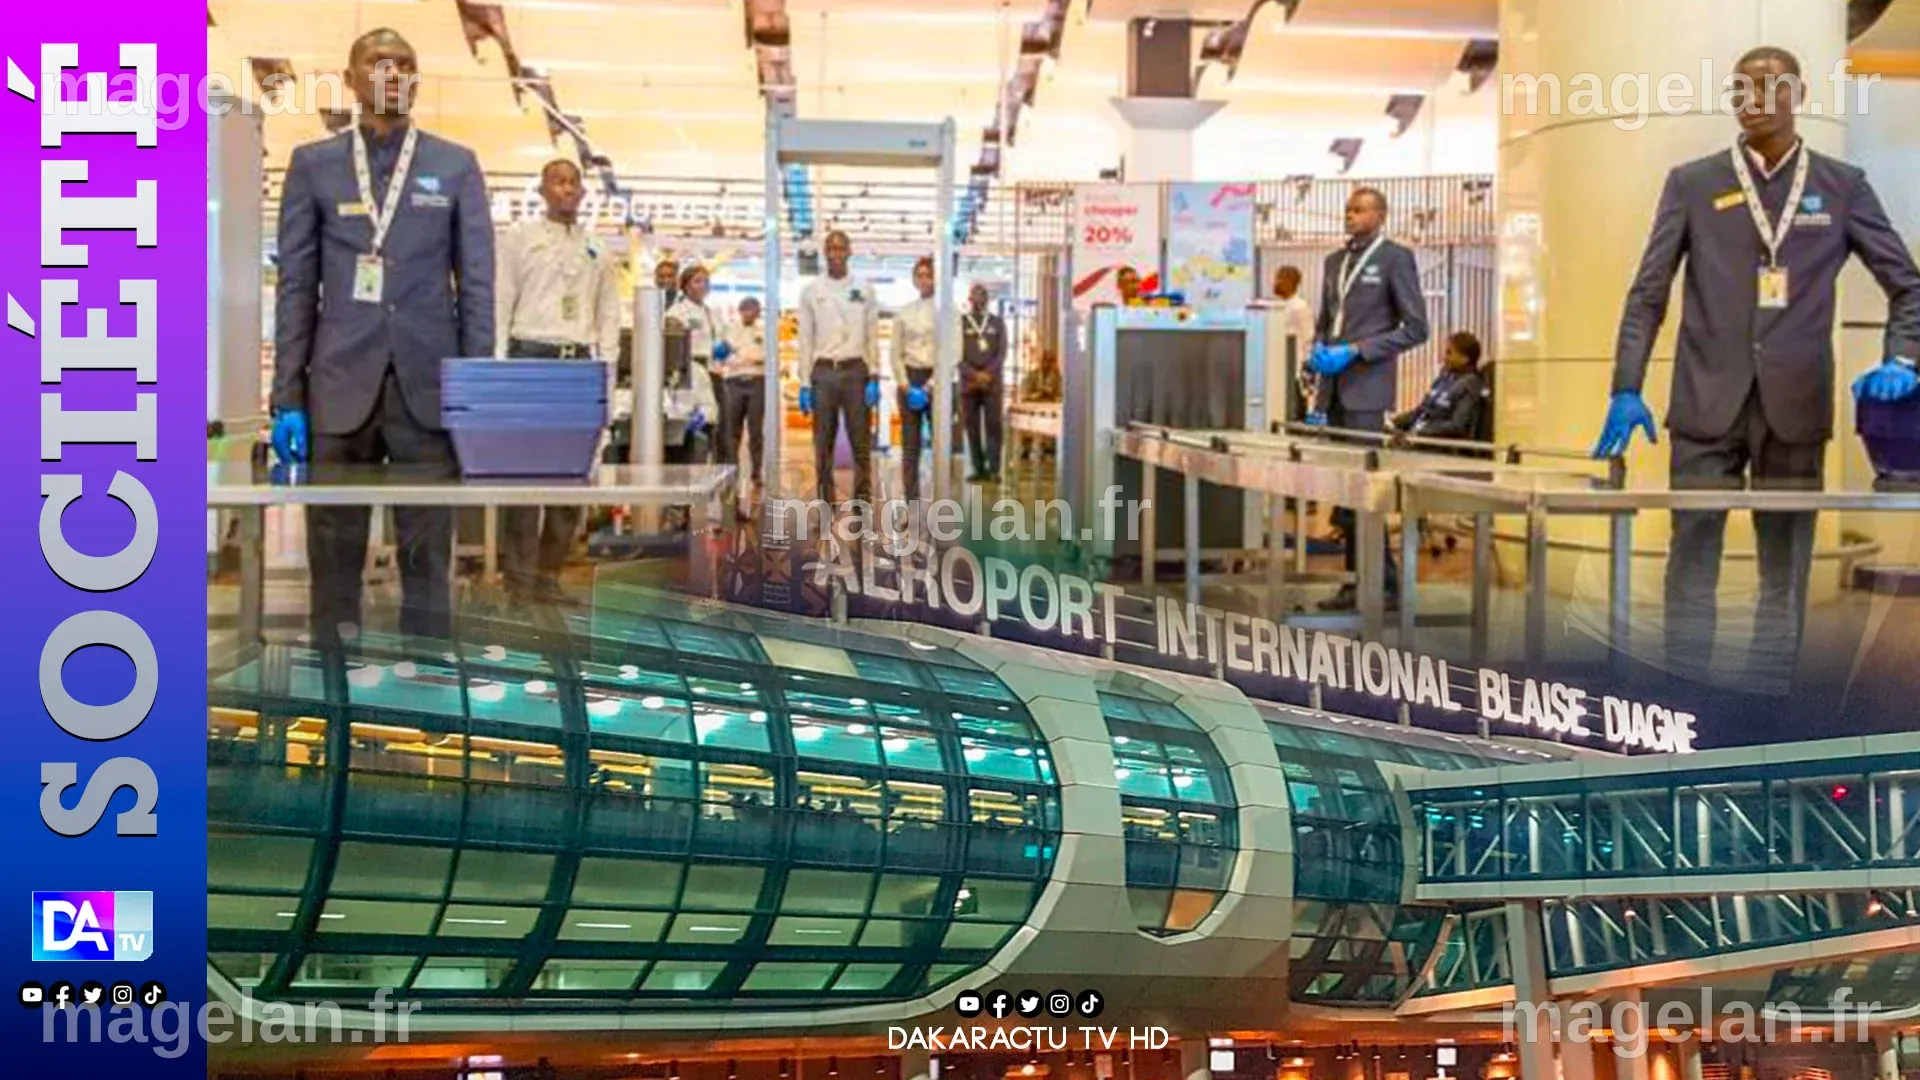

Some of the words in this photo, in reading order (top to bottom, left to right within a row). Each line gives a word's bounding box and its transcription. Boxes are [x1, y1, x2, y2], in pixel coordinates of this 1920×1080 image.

[1084, 225, 1133, 244] 20%
[1156, 595, 1462, 711] INTERNATIONAL
[1479, 668, 1590, 736] BLAISE
[1603, 696, 1697, 753] DIAGNE
